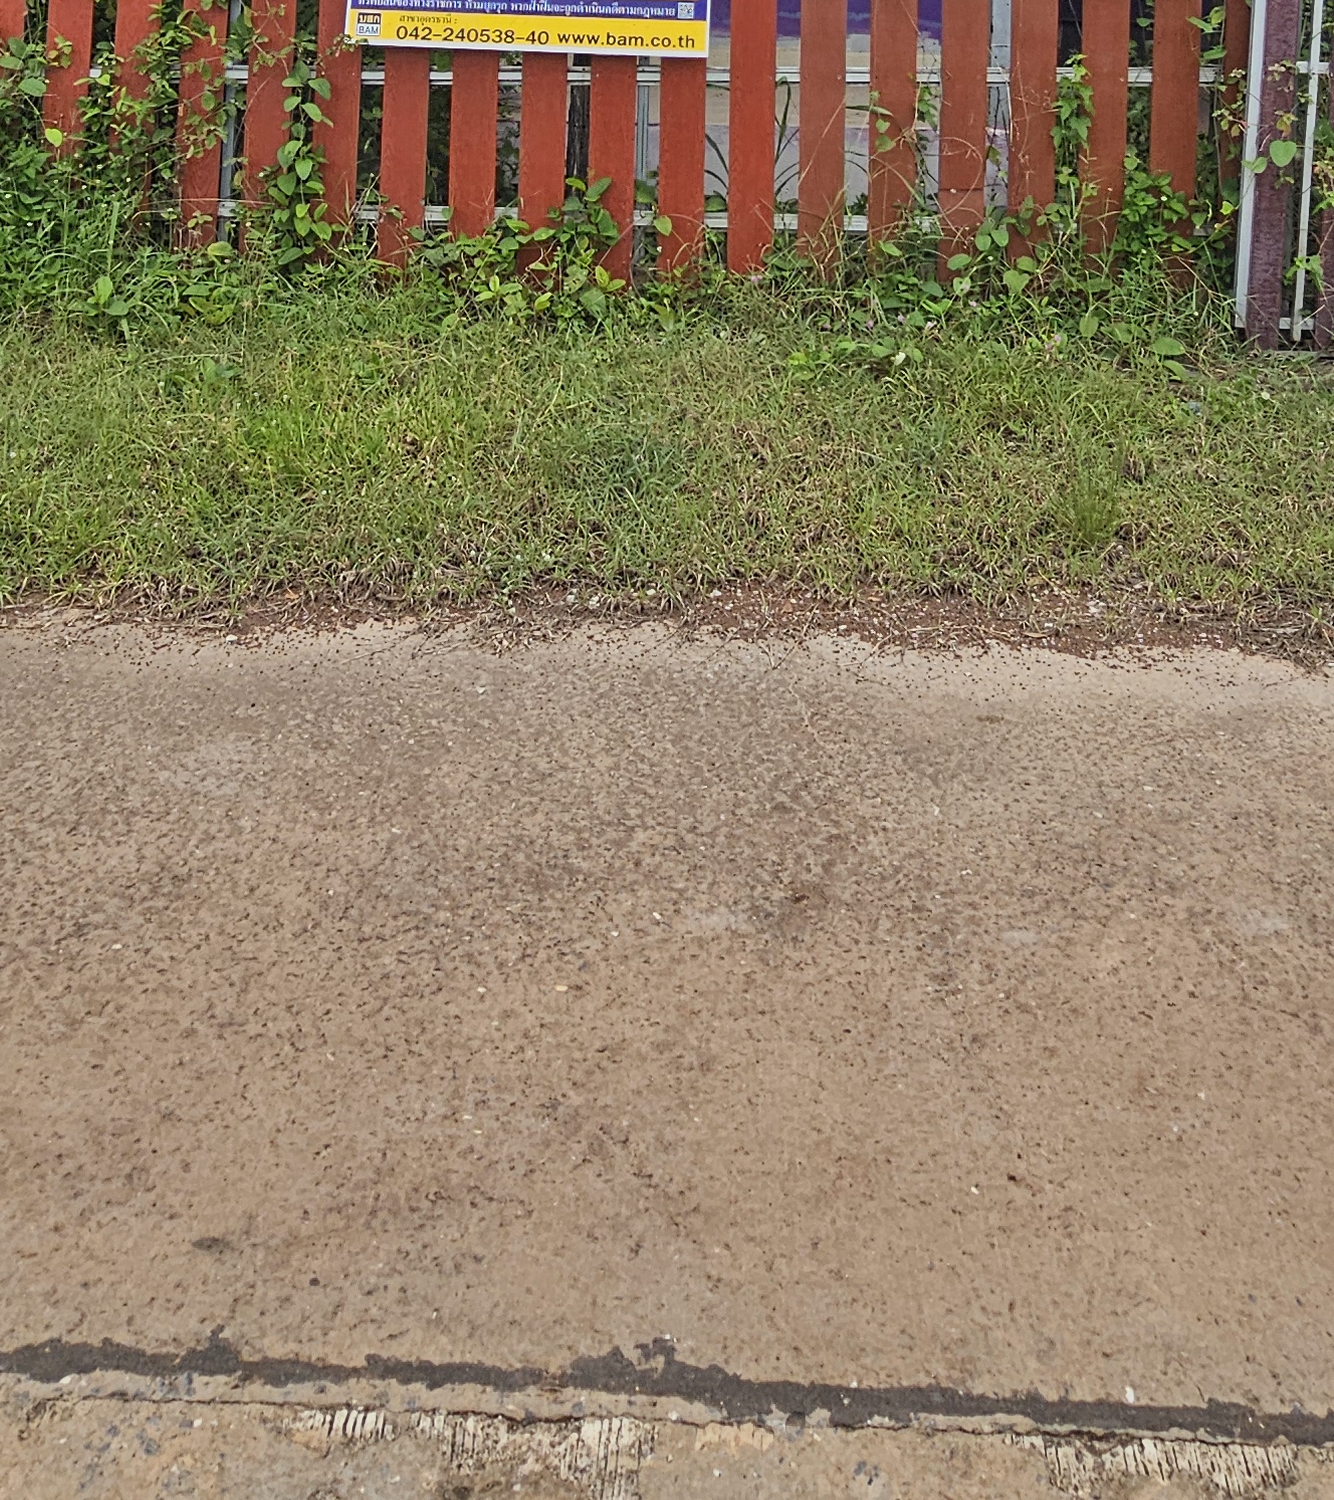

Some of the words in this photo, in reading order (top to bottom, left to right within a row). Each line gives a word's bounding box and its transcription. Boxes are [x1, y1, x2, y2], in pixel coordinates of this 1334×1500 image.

[358, 14, 380, 24] บสก
[358, 25, 379, 34] BAM
[396, 25, 550, 45] 042-240538-40
[557, 31, 695, 49] www.bam.co.th
